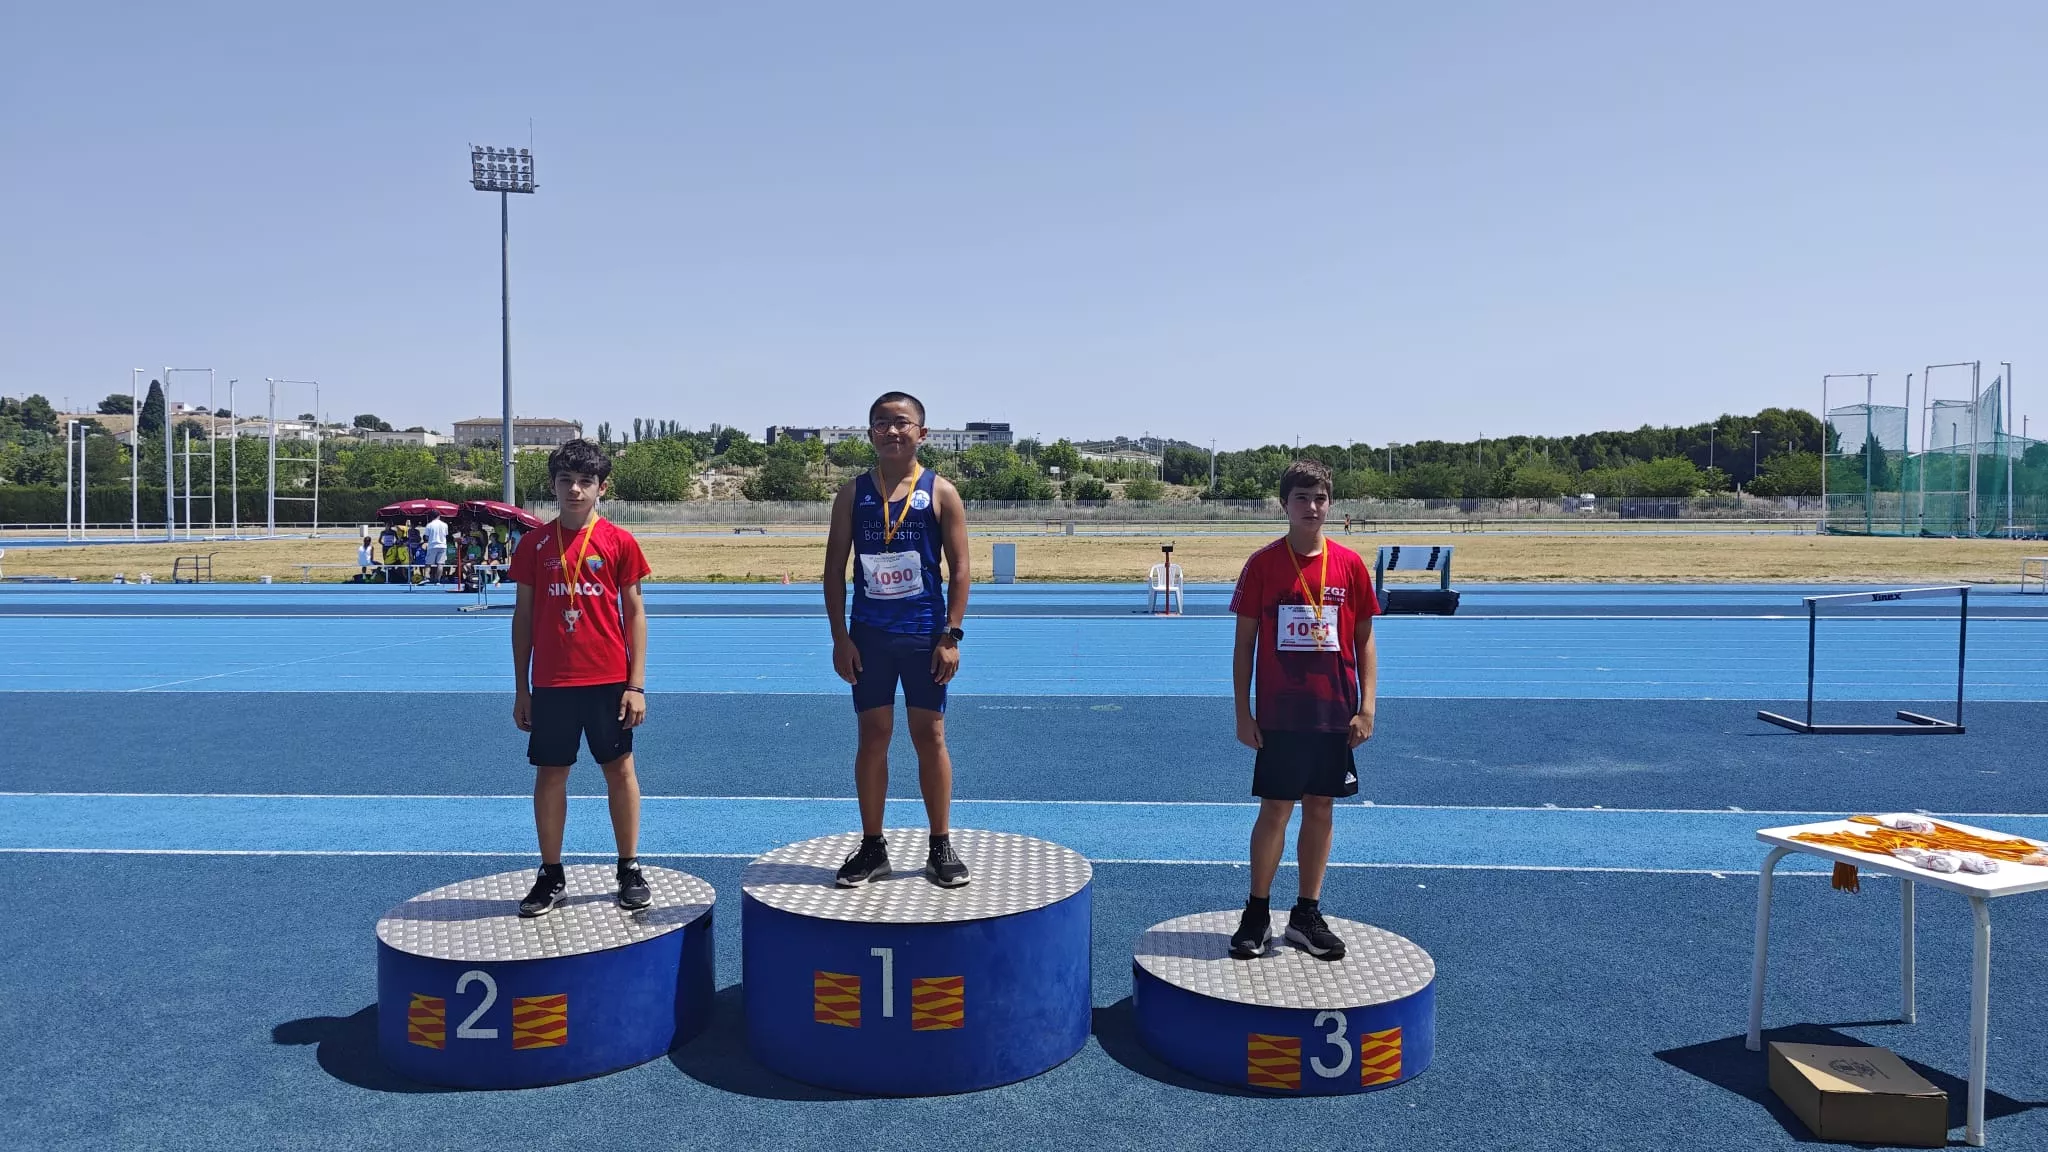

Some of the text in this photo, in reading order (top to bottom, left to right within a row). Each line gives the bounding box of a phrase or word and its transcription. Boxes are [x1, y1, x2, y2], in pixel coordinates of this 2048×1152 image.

[864, 529, 921, 541] Barastro
[872, 568, 914, 585] 1090
[548, 583, 603, 597] SINACO
[1323, 586, 1346, 597] ZGZ
[870, 947, 894, 1018] 1
[455, 969, 499, 1039] 2
[1309, 1010, 1353, 1079] 3
